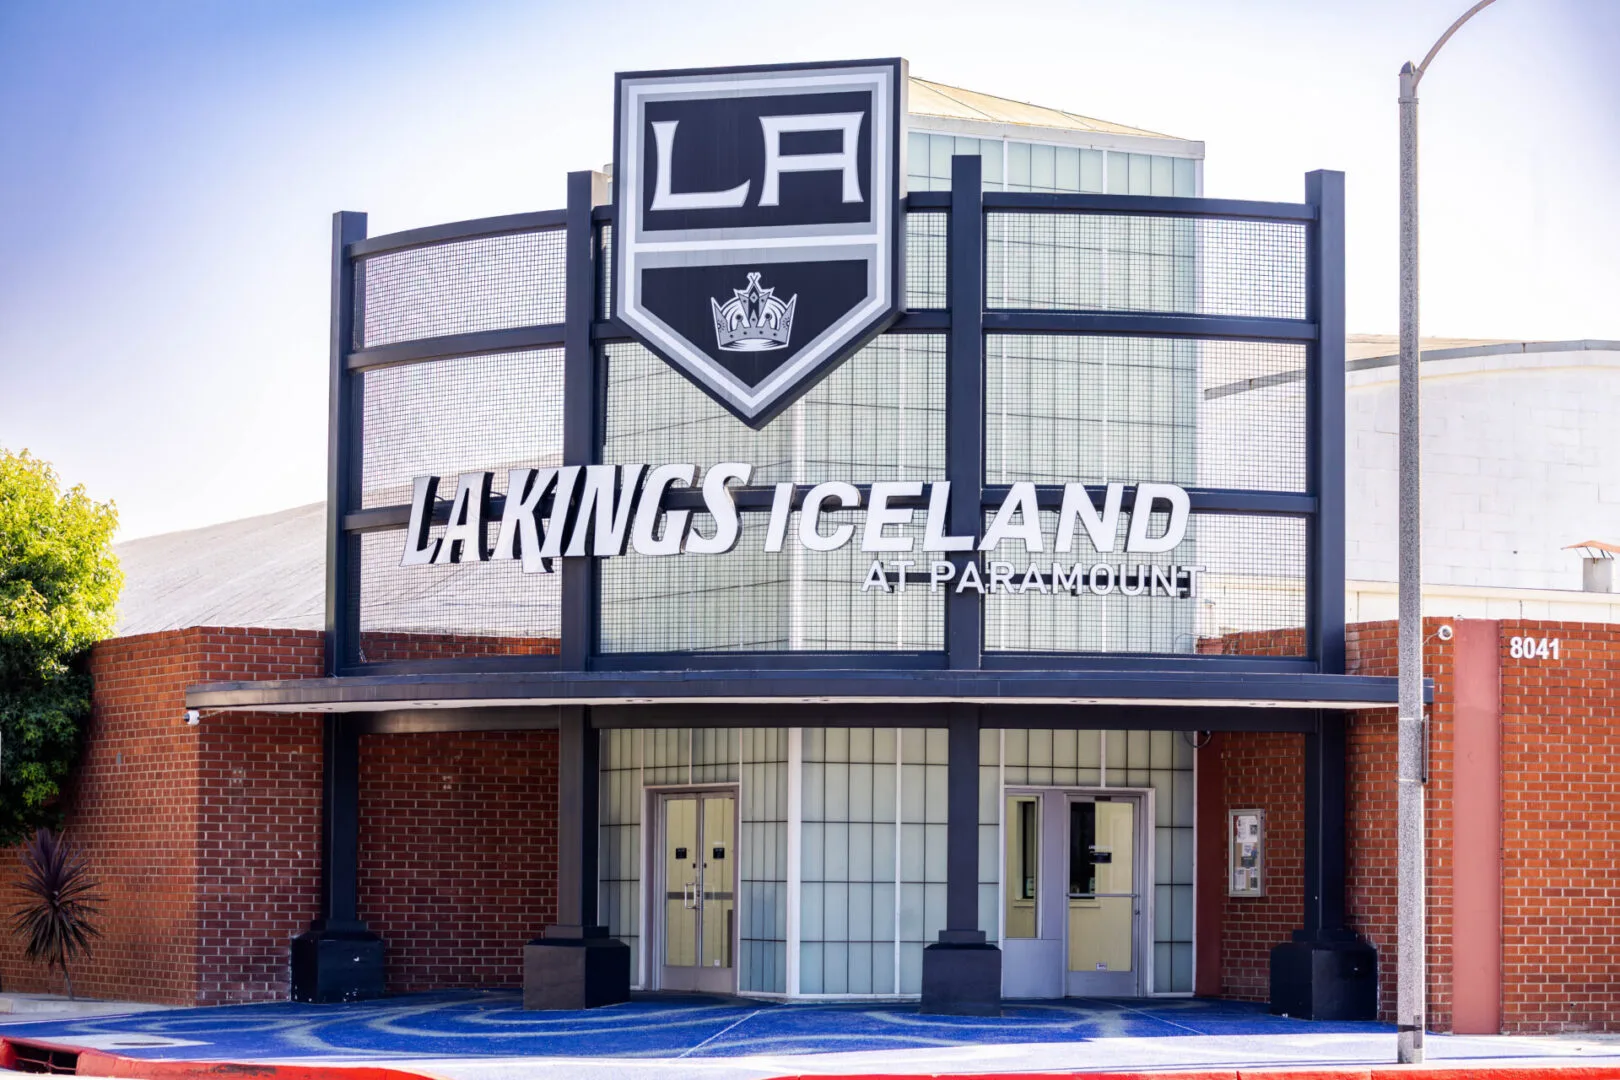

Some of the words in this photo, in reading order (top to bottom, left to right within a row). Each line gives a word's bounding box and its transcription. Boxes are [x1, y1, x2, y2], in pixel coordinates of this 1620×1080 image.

[650, 111, 864, 210] LA
[764, 480, 1191, 553] ICELAND
[861, 559, 915, 593] AT
[930, 560, 1206, 598] PARAMOUNT
[1509, 636, 1560, 660] 8041
